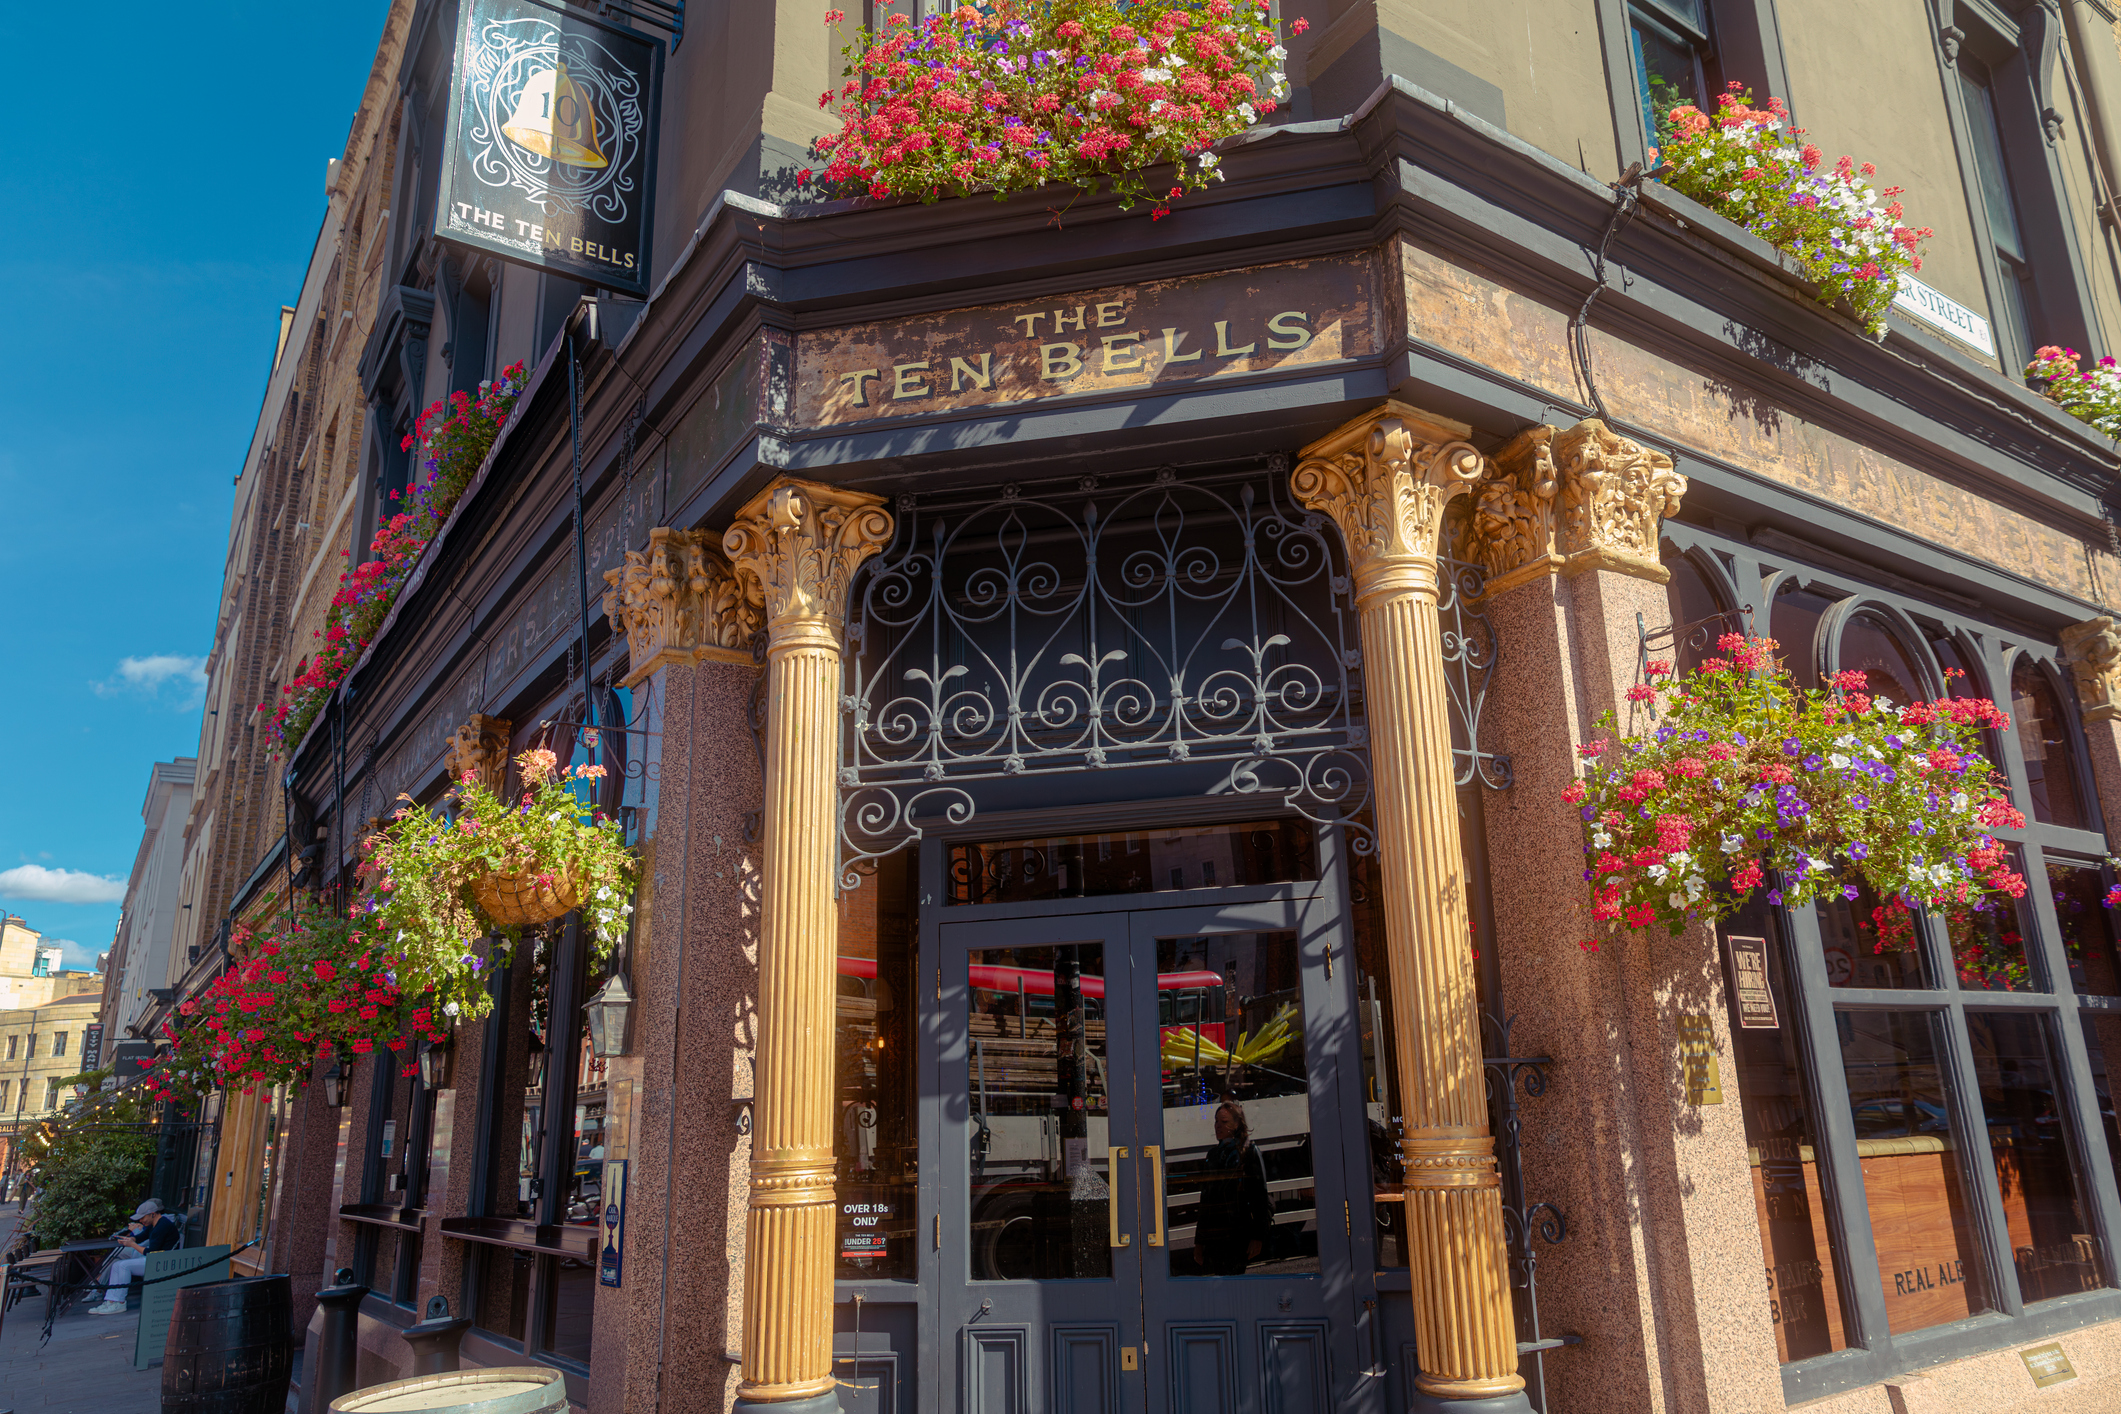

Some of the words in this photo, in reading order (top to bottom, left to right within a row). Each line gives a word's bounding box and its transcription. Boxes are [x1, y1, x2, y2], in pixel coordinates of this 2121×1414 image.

[540, 92, 581, 127] 10
[457, 202, 505, 230] THE
[515, 219, 561, 246] TEN
[570, 236, 635, 268] BELLS
[1015, 300, 1131, 339] THE
[1917, 285, 1975, 334] STREET
[839, 352, 993, 408] TEN
[1040, 311, 1316, 381] BELLS
[1735, 951, 1761, 970] WE'RE
[1738, 970, 1765, 990] HIRING
[844, 1204, 870, 1213] OVER
[872, 1203, 889, 1213] 18s
[853, 1217, 878, 1226] ONLY
[872, 1237, 886, 1245] 25?
[155, 1256, 204, 1273] CUBITTS
[1893, 1266, 1936, 1296] REAL
[1939, 1259, 1966, 1287] ALE
[1770, 1294, 1808, 1325] BAR
